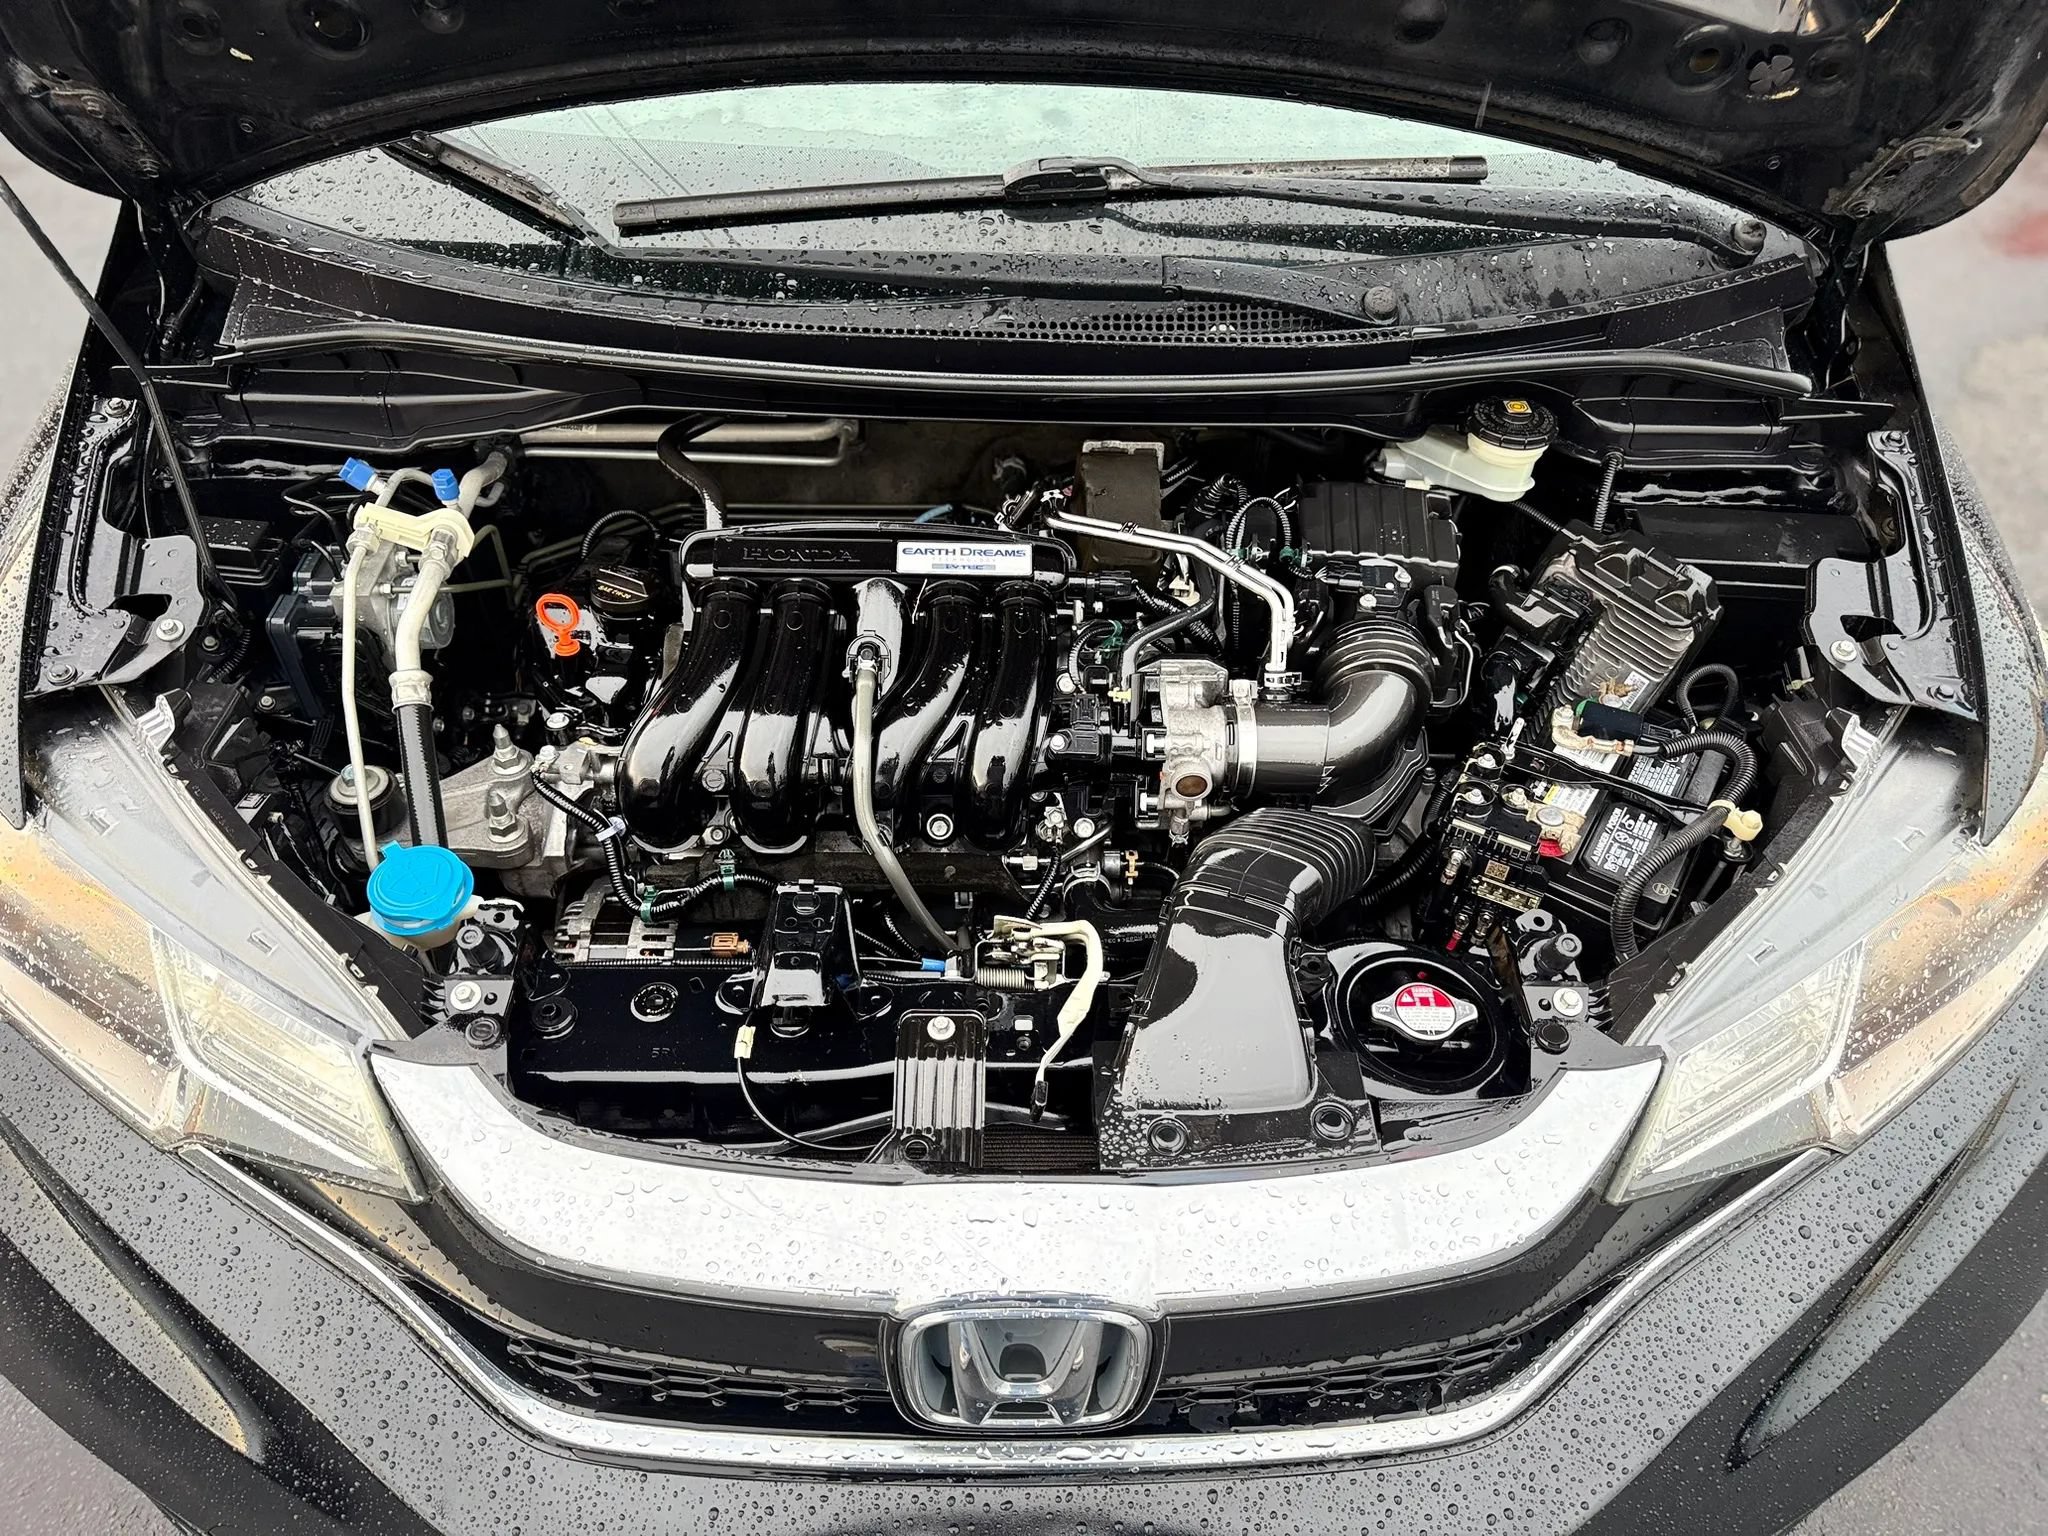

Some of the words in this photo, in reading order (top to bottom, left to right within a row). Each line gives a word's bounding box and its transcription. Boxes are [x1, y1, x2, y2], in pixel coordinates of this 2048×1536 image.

[742, 547, 861, 562] HONDA
[902, 547, 956, 556] EARTH
[960, 547, 1026, 558] DREAMS
[1591, 830, 1611, 857] DANGER
[1604, 806, 1623, 830] POISON
